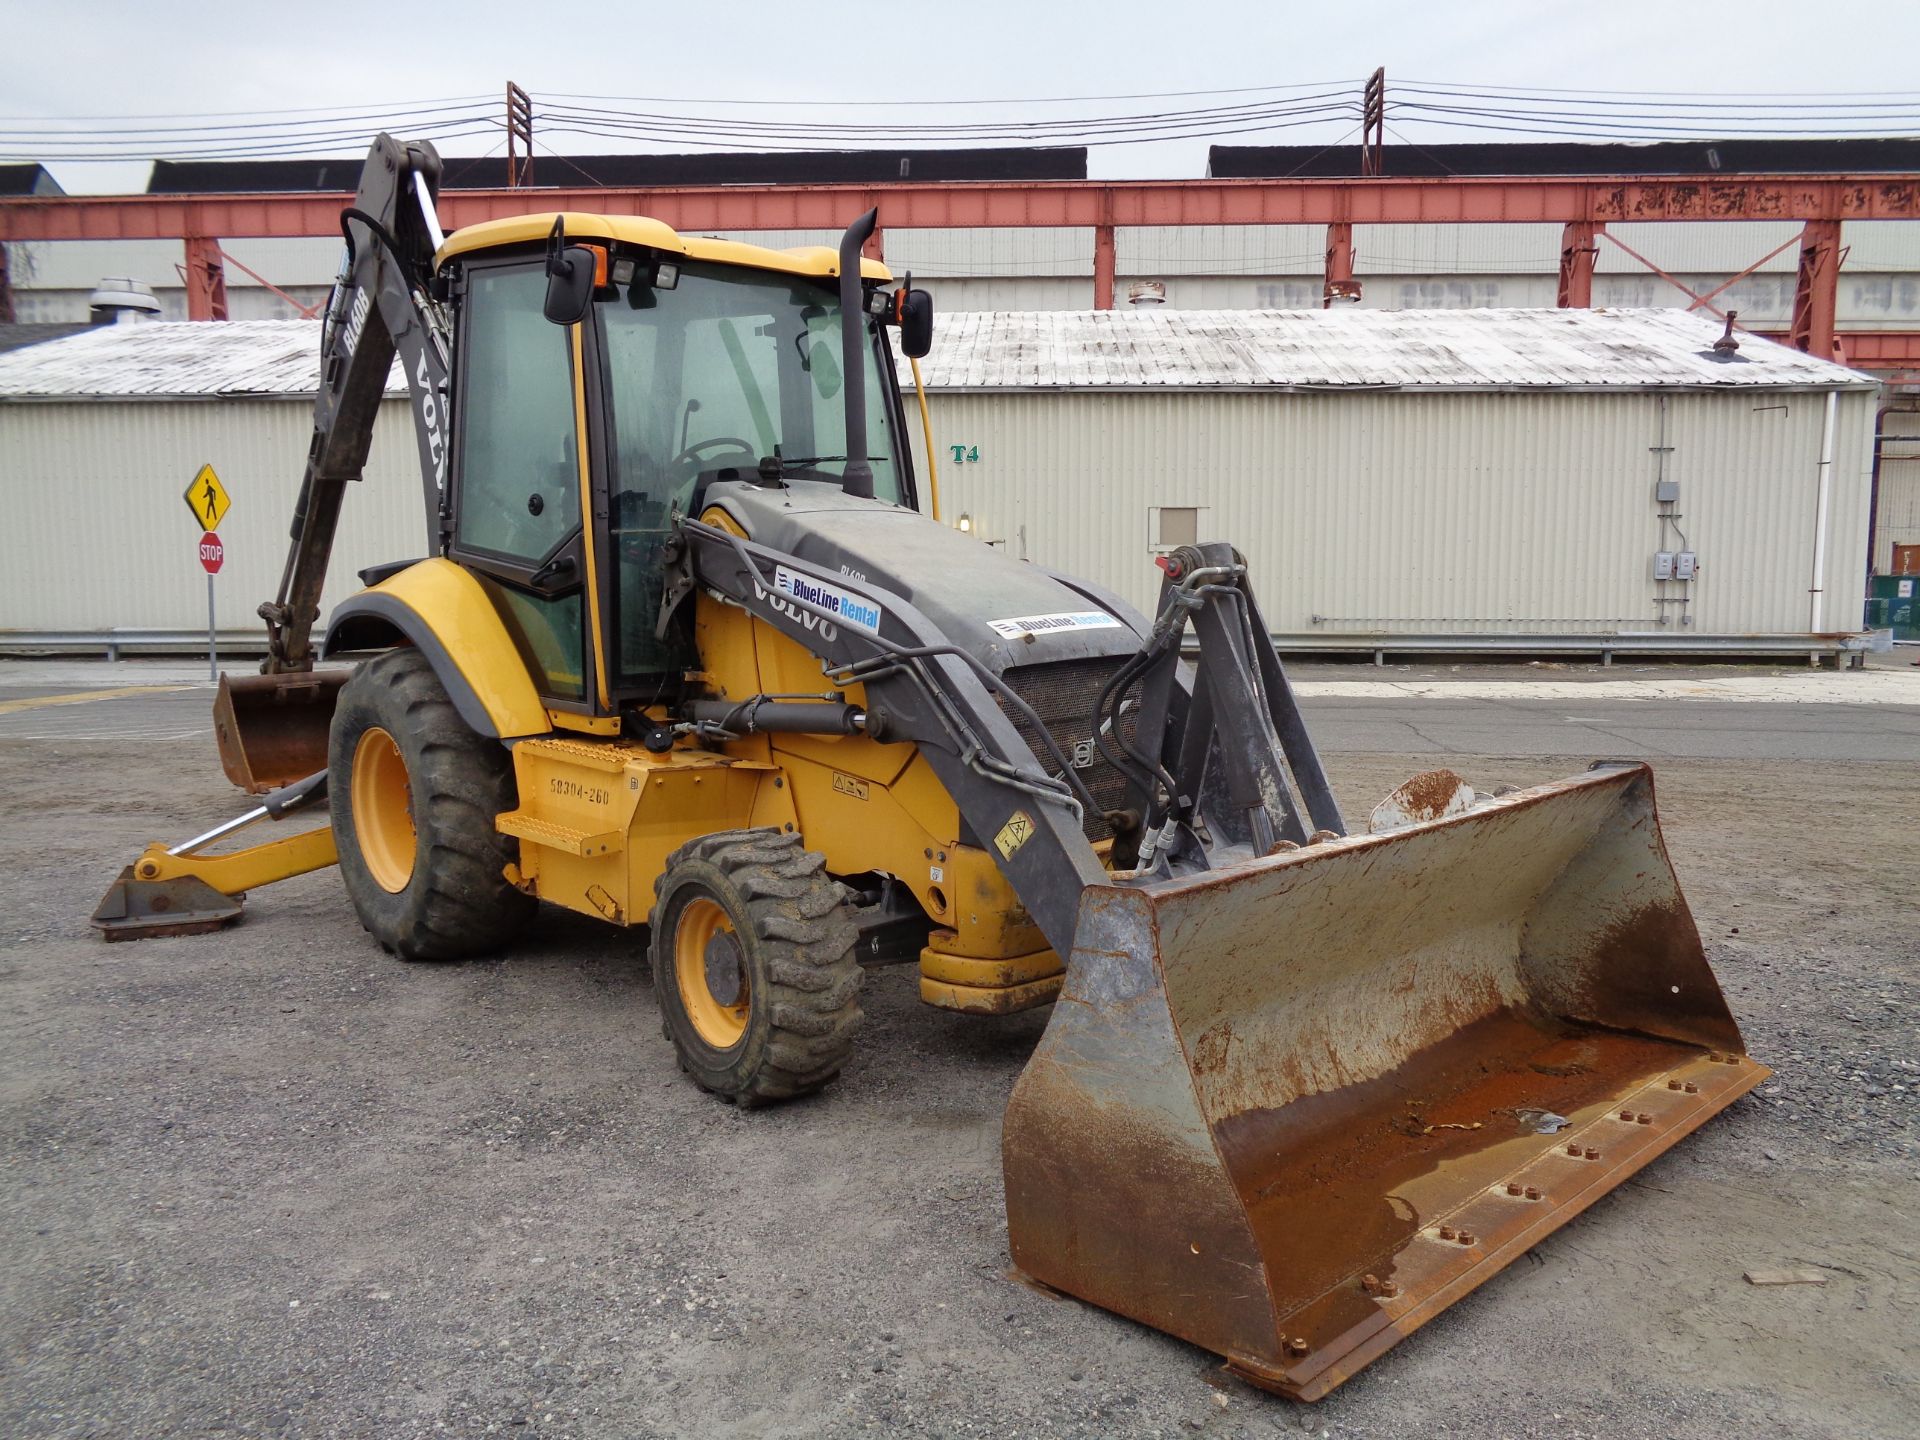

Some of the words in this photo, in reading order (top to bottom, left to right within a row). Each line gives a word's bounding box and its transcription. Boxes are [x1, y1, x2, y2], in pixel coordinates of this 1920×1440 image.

[342, 286, 370, 356] BL60B
[416, 347, 445, 490] VOLV
[950, 444, 980, 463] T4
[200, 543, 223, 562] STOP
[793, 578, 840, 613] BlueLine
[839, 596, 879, 629] Rental
[1016, 616, 1076, 632] BlueLine
[1070, 614, 1115, 625] Rental
[551, 778, 609, 805] 58304-260
